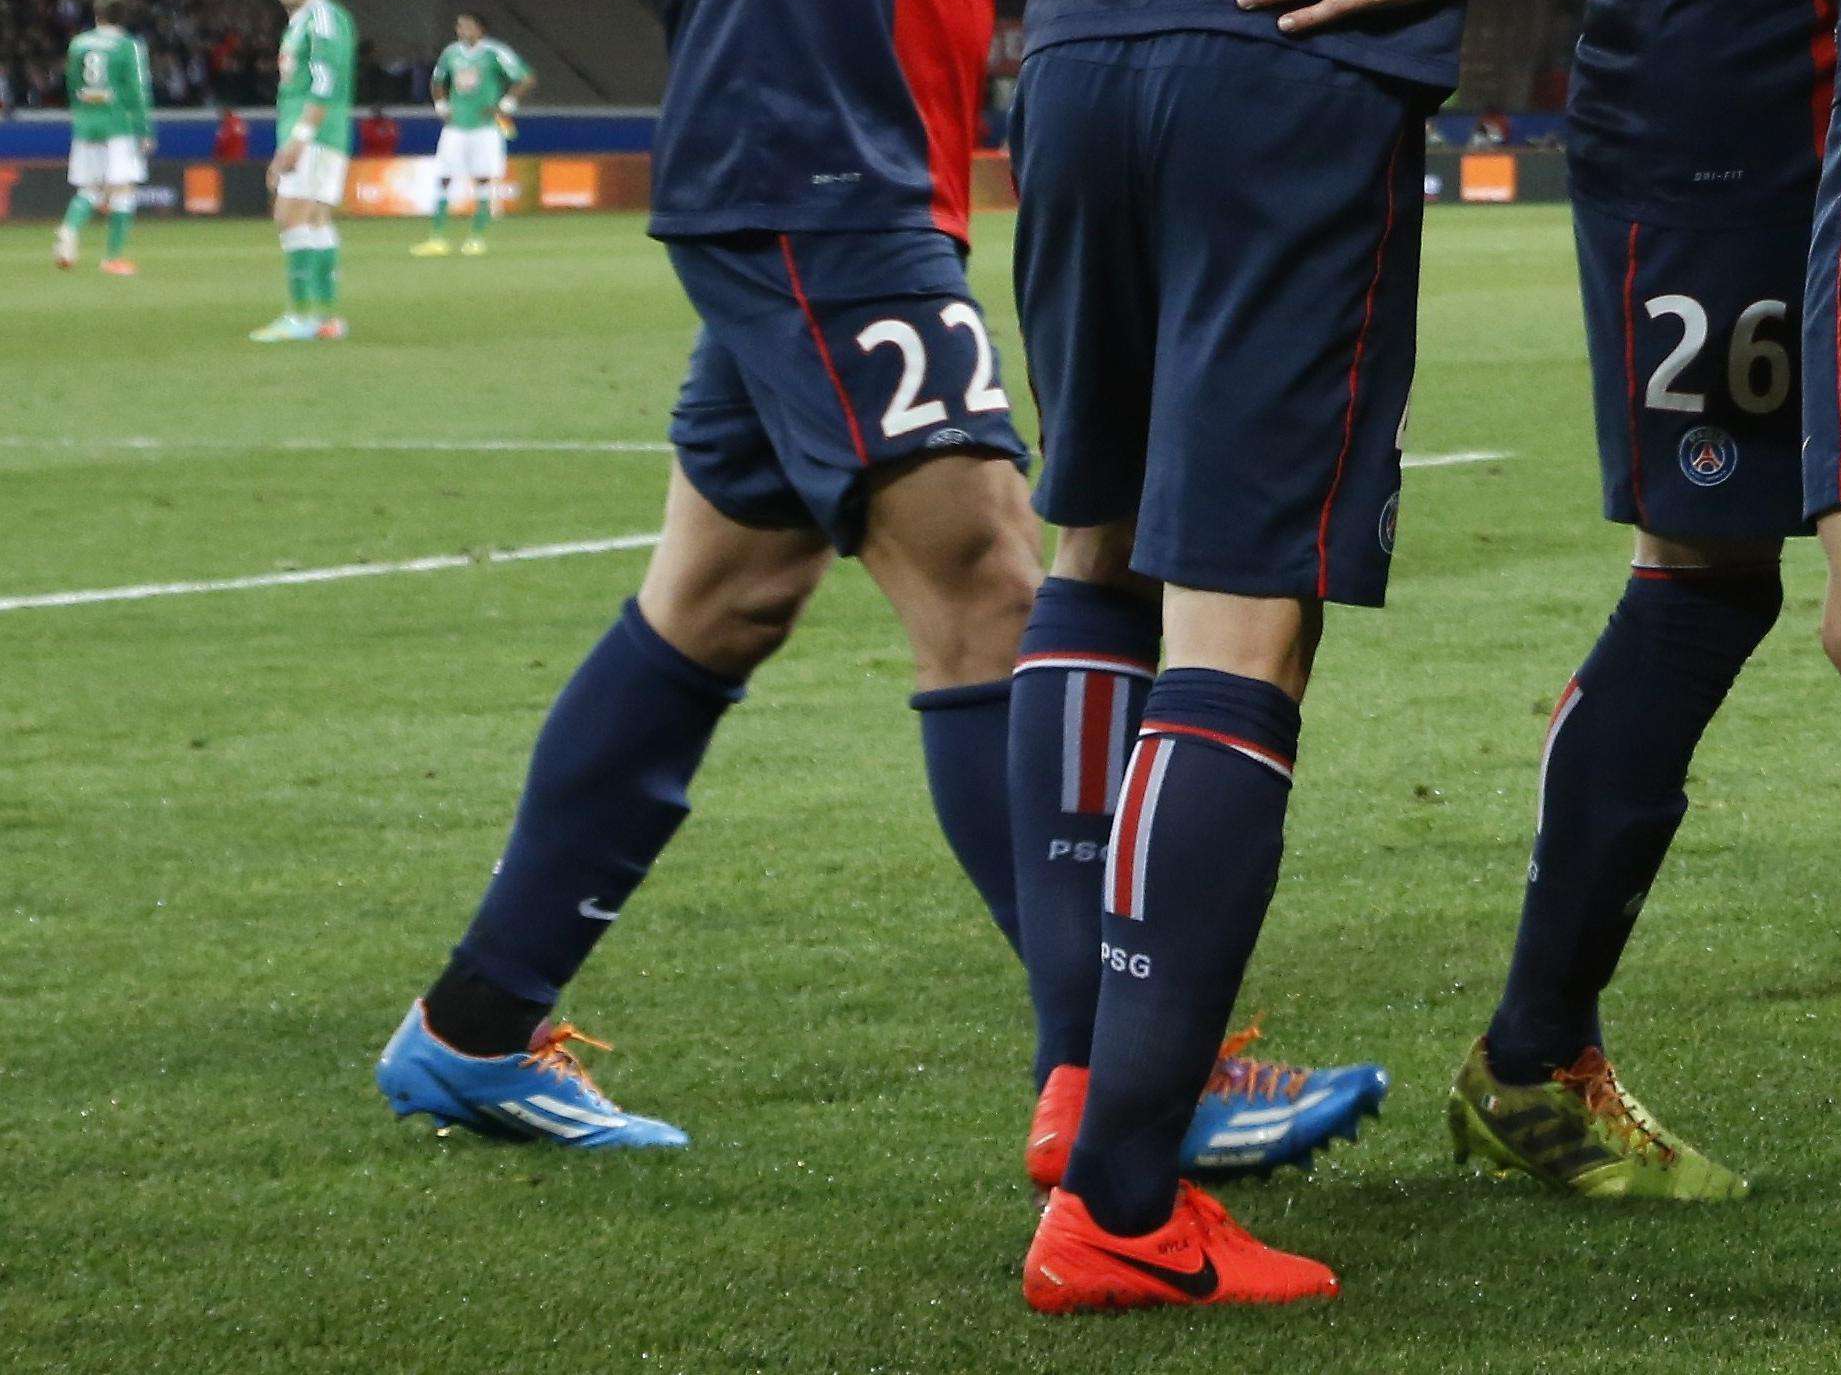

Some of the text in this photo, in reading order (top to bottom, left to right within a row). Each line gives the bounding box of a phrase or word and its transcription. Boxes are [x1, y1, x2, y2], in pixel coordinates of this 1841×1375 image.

[856, 301, 1010, 438] 22
[1644, 293, 1791, 414] 26
[1048, 838, 1108, 863] PS
[1101, 941, 1151, 980] PSG
